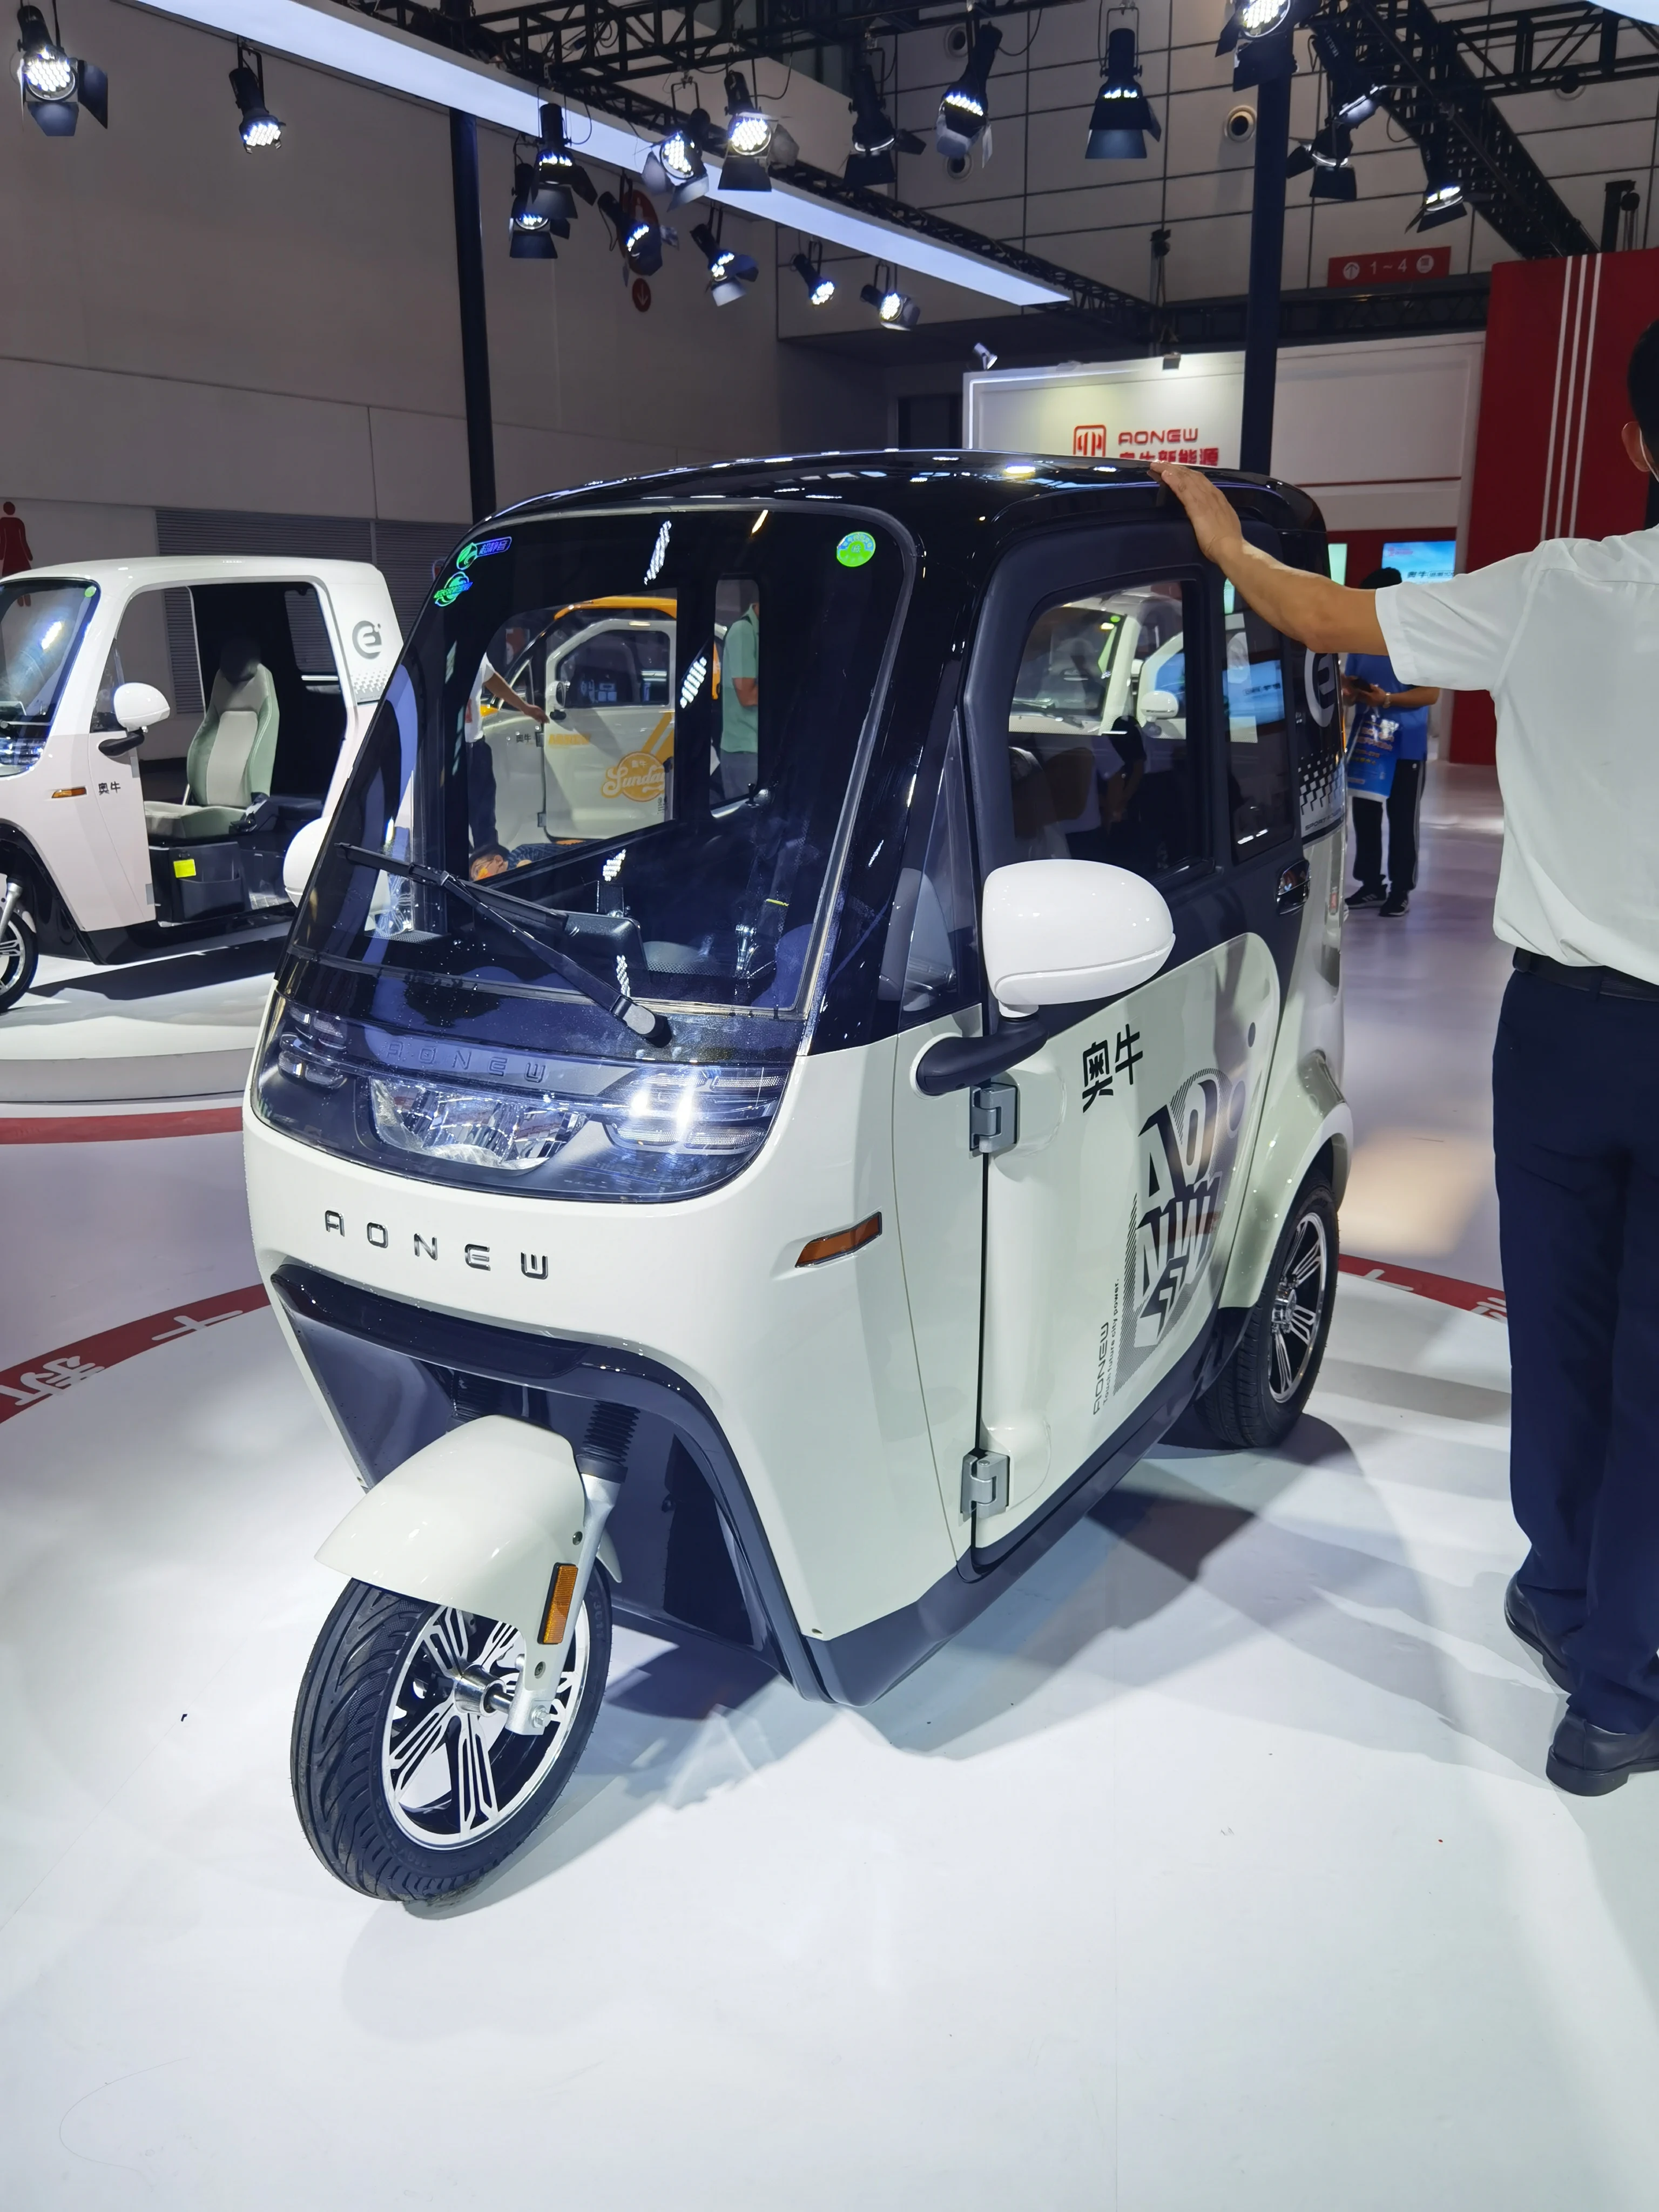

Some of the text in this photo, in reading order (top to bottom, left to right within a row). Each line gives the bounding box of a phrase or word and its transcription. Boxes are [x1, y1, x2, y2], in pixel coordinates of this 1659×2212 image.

[1118, 428, 1198, 445] AONEW
[98, 781, 121, 795] 奥牛
[386, 1040, 547, 1083] AONEW
[1082, 1023, 1144, 1114] 奥牛
[325, 1209, 549, 1280] AONEW
[1093, 1321, 1109, 1415] AONEW
[1103, 1373, 1111, 1406] Touch
[1107, 1339, 1115, 1372] future
